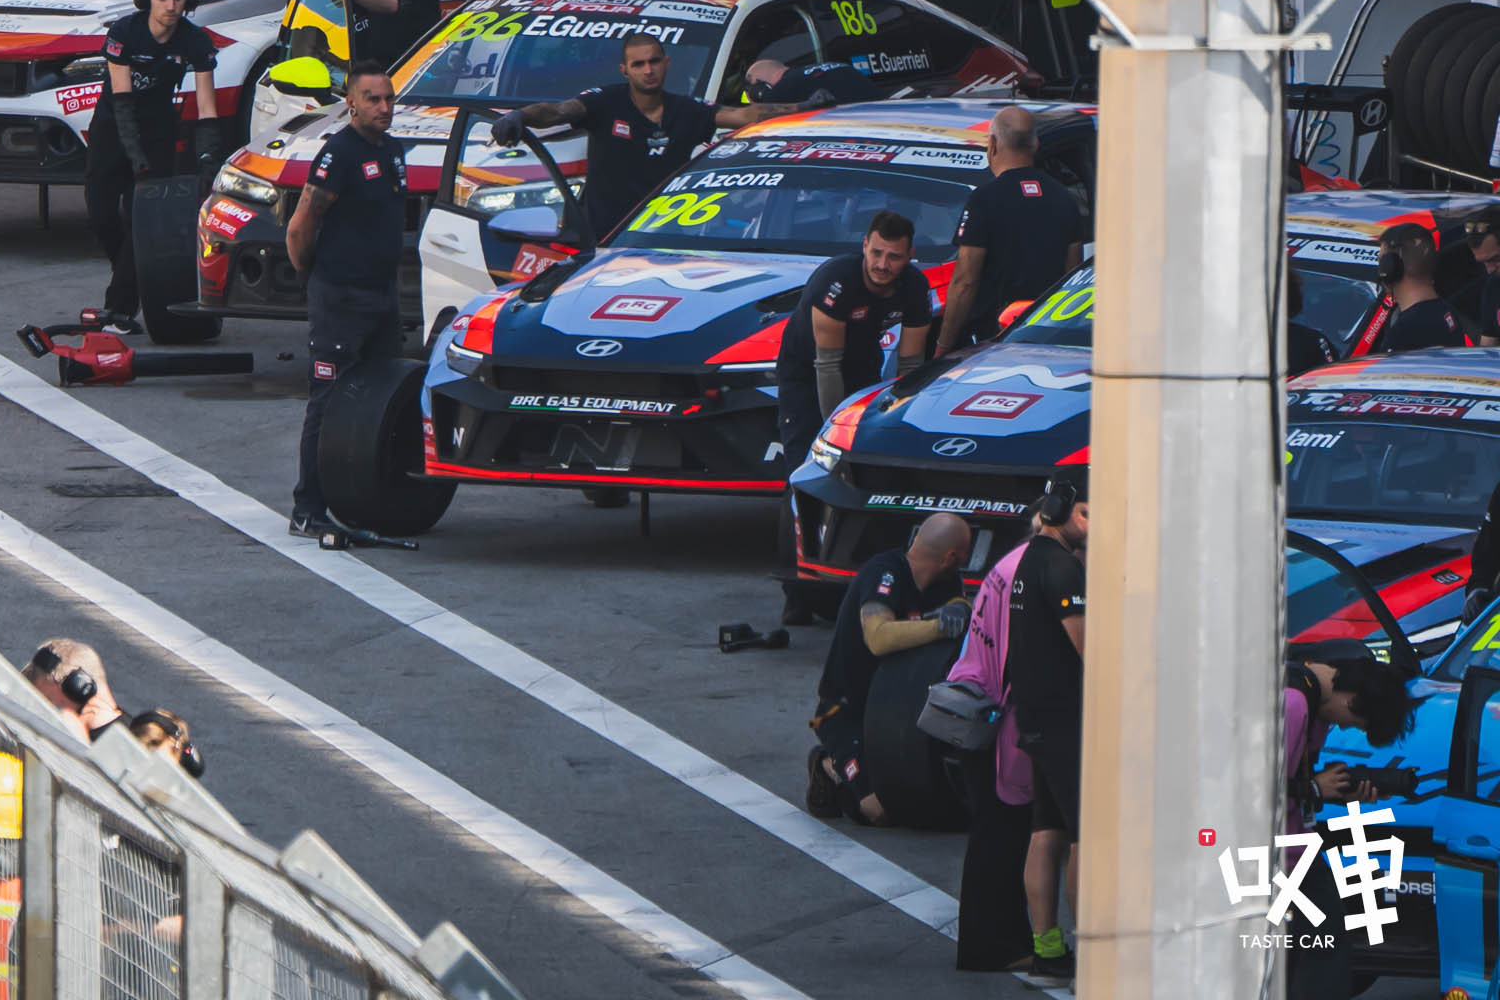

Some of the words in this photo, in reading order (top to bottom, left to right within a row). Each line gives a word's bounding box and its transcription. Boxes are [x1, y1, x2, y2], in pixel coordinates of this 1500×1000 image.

[566, 3, 637, 14] TOUR
[658, 3, 729, 18] KUMHO
[696, 13, 727, 22] TIRE
[829, 0, 878, 36] 186
[430, 10, 530, 44] 186
[815, 142, 882, 151] WORLD
[814, 150, 889, 162] TOUR
[911, 149, 985, 162] KUMHO
[950, 157, 983, 166] TIRE
[662, 177, 688, 193] M.
[693, 171, 785, 189] Azcona
[628, 192, 729, 231] 196
[516, 251, 537, 274] 72
[615, 301, 657, 311] BRC
[510, 395, 544, 407] BRC
[546, 396, 579, 409] GAS
[582, 398, 677, 414] EQUIPMENT
[977, 397, 1018, 408] BRC
[1377, 403, 1460, 416] TOUR
[1287, 429, 1346, 449] lami
[867, 494, 898, 505] BRC
[901, 496, 936, 507] GAS
[939, 497, 1029, 515] EQUIPMENT
